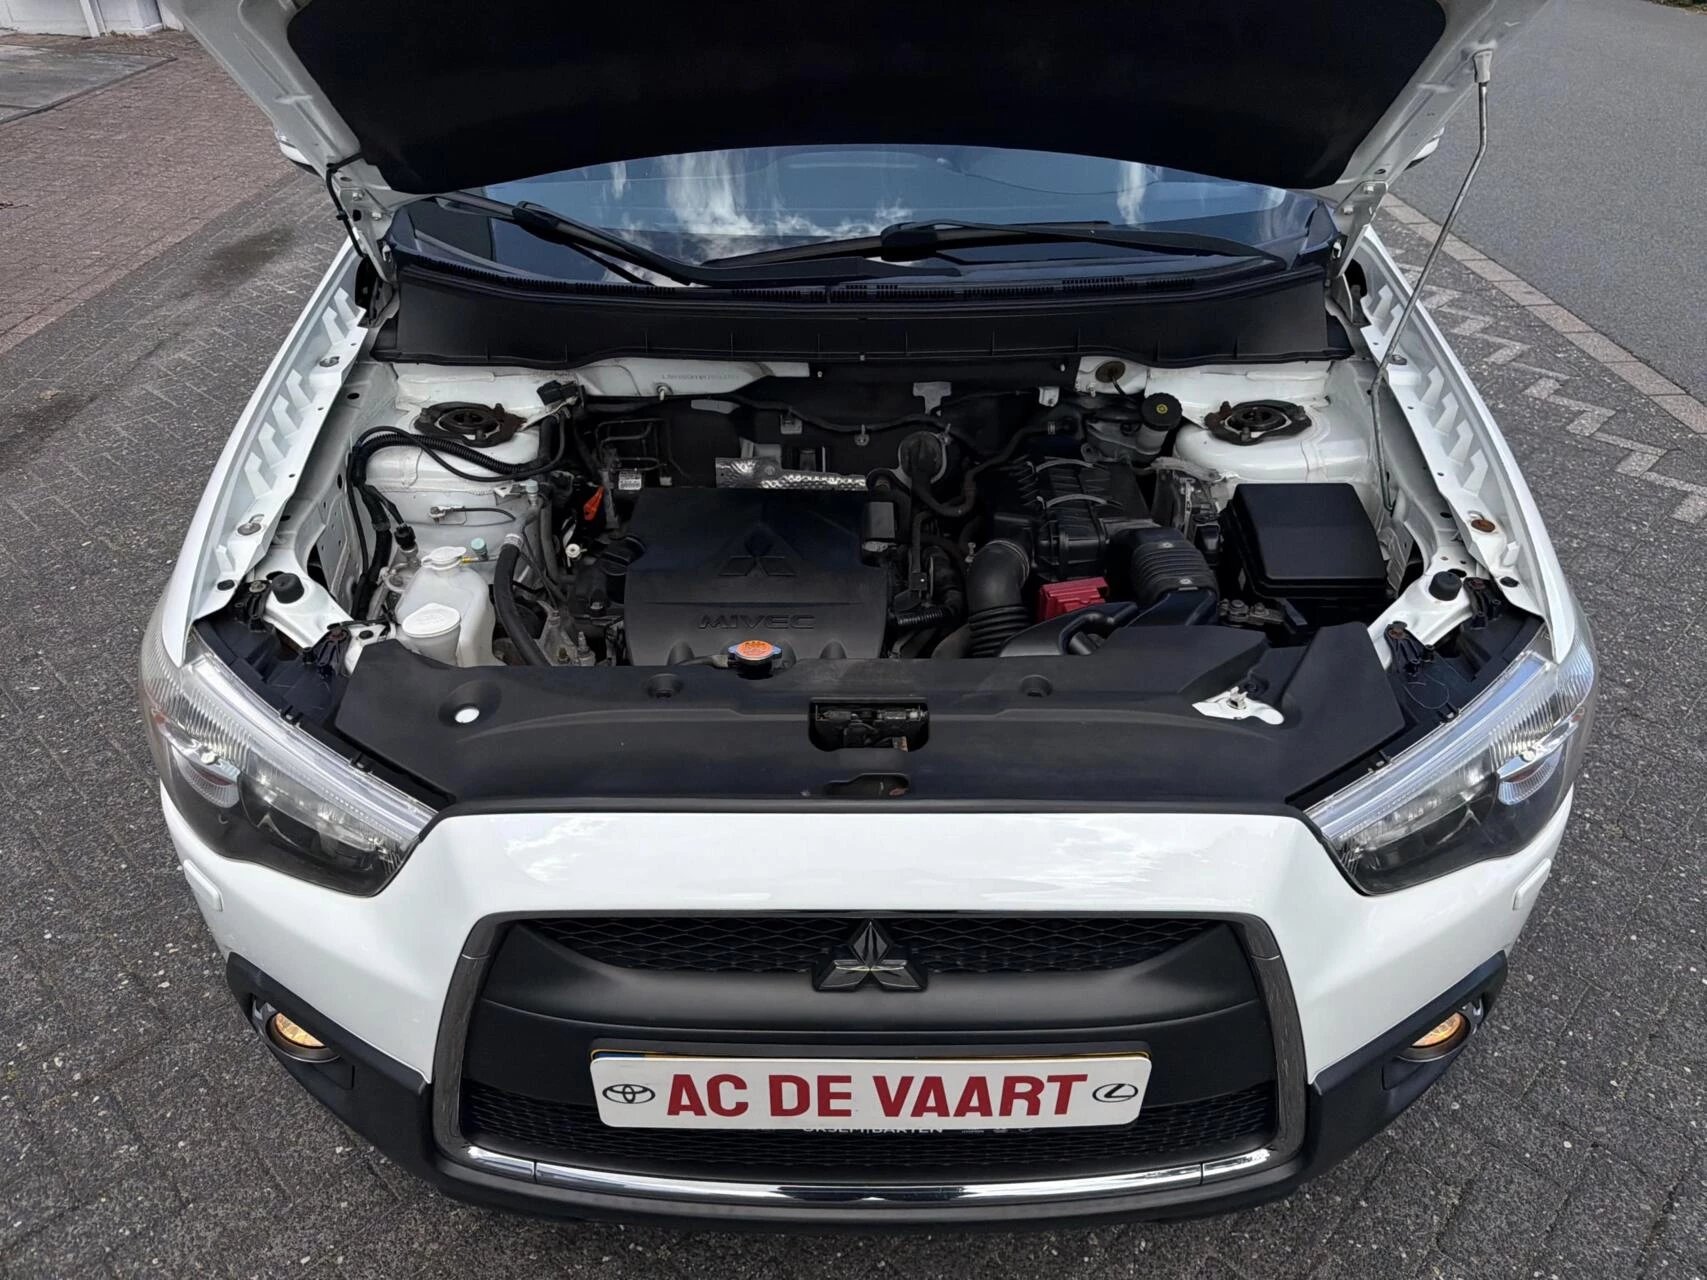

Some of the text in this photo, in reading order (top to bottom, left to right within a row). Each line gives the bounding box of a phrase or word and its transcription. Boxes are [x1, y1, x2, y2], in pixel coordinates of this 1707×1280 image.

[698, 614, 816, 630] MIVEC
[667, 1073, 1088, 1117] AC DE VAART
